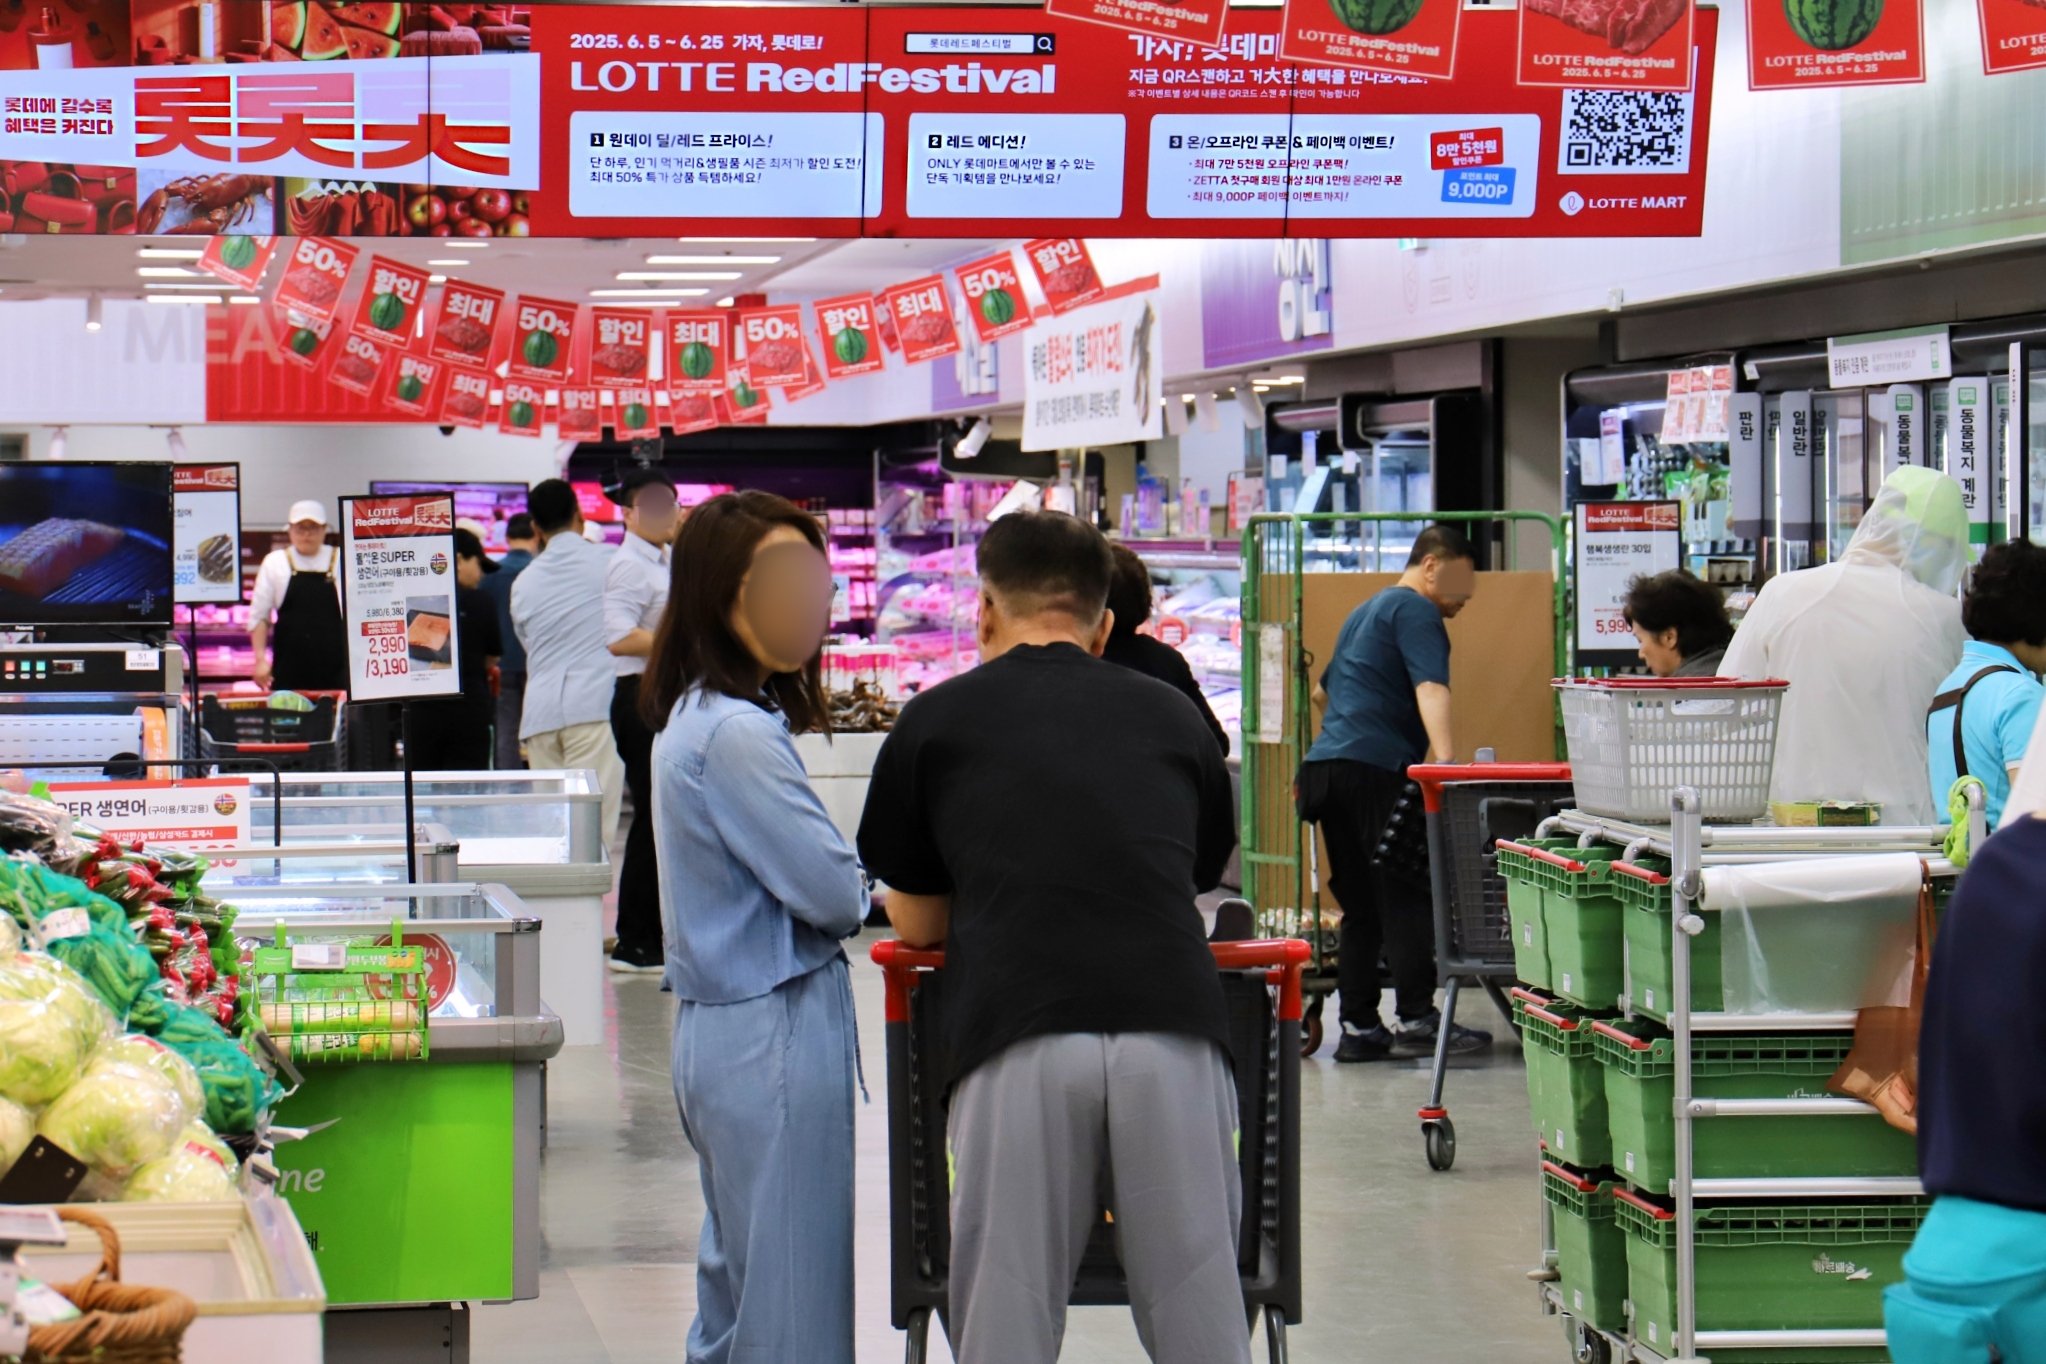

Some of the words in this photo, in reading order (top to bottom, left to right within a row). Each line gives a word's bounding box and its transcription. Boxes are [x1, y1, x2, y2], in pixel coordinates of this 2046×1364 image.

[1094, 4, 1123, 18] 2025.
[1163, 19, 1177, 28] 25
[570, 34, 624, 50] 2025.
[627, 34, 645, 49] 6.
[648, 34, 661, 49] 5
[680, 34, 697, 49] 6.
[700, 34, 724, 49] 25
[733, 35, 767, 52] 가자,
[771, 35, 823, 51] 롯데로!
[929, 38, 1012, 50] 롯데레드페스티벌
[1298, 29, 1346, 44] LOTTE
[1349, 35, 1440, 57] RedFestival
[2000, 32, 2046, 49] LOTTE
[1326, 44, 1354, 58] 2025.
[1396, 55, 1409, 64] 25
[1533, 54, 1582, 67] LOTTE
[1584, 56, 1675, 70] RedFestival
[1765, 54, 1813, 67] LOTTE
[1816, 50, 1907, 65] RedFestival
[571, 61, 736, 92] LOTTE
[747, 62, 1056, 94] RedFestival
[1129, 69, 1158, 83] 지금
[1163, 68, 1245, 85] QR스캔하고
[1302, 69, 1346, 85] 혜택을
[1562, 68, 1590, 79] 2025.
[1632, 69, 1646, 79] 25
[1795, 66, 1823, 77] 2025.
[1865, 64, 1878, 74] 25
[1183, 89, 1200, 98] 상세
[1203, 90, 1226, 98] 내용은
[1228, 90, 1257, 98] QR코드
[1260, 89, 1276, 98] 스캔
[1279, 90, 1288, 98] 후
[1319, 89, 1360, 99] 가능합니다
[5, 97, 56, 113] 롯데에
[61, 98, 113, 114] 갈수록
[5, 118, 56, 134] 혜택은
[62, 119, 114, 135] 커진다
[609, 133, 653, 149] 원데이
[657, 133, 706, 149] 딜/레드
[709, 133, 774, 149] 프라이스!
[946, 135, 974, 149] 레드
[978, 135, 1026, 149] 에디션!
[1187, 136, 1258, 150] 온/오프라인
[1261, 136, 1289, 149] 쿠폰
[1292, 137, 1303, 149] &
[1306, 136, 1345, 150] 페이백
[1349, 136, 1394, 150] 이벤트!
[1459, 132, 1474, 140] 최대
[1436, 143, 1459, 158] 8만
[1462, 140, 1498, 157] 5천원
[590, 157, 602, 169] 단
[605, 157, 632, 170] 하루,
[635, 157, 657, 169] 인기
[661, 156, 740, 170] 먹거리&생필품
[744, 157, 767, 169] 시즌
[770, 157, 805, 170] 최저가
[808, 157, 830, 169] 할인
[833, 157, 861, 170] 도전!
[928, 158, 960, 169] ONLY
[963, 158, 1043, 170] 롯데마트에서만
[1046, 158, 1057, 170] 볼
[1060, 158, 1070, 169] 수
[1073, 158, 1096, 170] 있는
[1194, 158, 1214, 169] 최대
[1217, 158, 1235, 169] 7만
[1238, 158, 1265, 170] 5천원
[1267, 158, 1309, 170] 오프라인
[1312, 158, 1348, 170] 쿠폰팩!
[1452, 156, 1483, 166] 할인쿠폰
[590, 171, 613, 184] 최대
[616, 171, 643, 183] 50%
[646, 171, 668, 183] 특가
[672, 171, 694, 184] 상품
[697, 171, 761, 185] 득템하세요!
[926, 173, 949, 184] 단독
[953, 173, 997, 185] 기획템을
[1000, 172, 1061, 185] 만나보세요!
[1193, 175, 1228, 185] ZETTA
[1231, 175, 1259, 185] 첫구매
[1261, 175, 1280, 185] 회원
[1283, 175, 1303, 185] 대상
[1305, 175, 1324, 185] 최대
[1327, 175, 1350, 185] 1만원
[1353, 175, 1381, 185] 온라인
[1384, 175, 1403, 185] 쿠폰
[1460, 172, 1482, 181] 포인트
[1484, 173, 1499, 182] 최대
[1193, 191, 1213, 202] 최대
[1215, 191, 1255, 203] 9,000P
[1258, 191, 1288, 202] 페이백
[1292, 190, 1347, 202] 이벤트까지!
[1448, 182, 1509, 199] 9,000P
[1589, 198, 1638, 209] LOTTE
[1641, 196, 1688, 209] MART
[295, 238, 346, 280] 50%
[1034, 238, 1084, 275] 할인
[372, 267, 421, 305] 할인
[964, 267, 1017, 300] 50%
[447, 291, 496, 326] 최대
[896, 286, 943, 319] 최대
[518, 305, 571, 337] 50%
[822, 302, 871, 337] 할인
[598, 319, 645, 347] 할인
[674, 321, 721, 348] 최대
[746, 317, 799, 342] 50%
[345, 337, 383, 366] 50%
[401, 356, 434, 384] 할인
[455, 373, 488, 399] 최대
[505, 383, 544, 405] 50%
[562, 389, 597, 411] 할인
[1738, 410, 1754, 442] 판란
[1792, 410, 1808, 458] 일반란
[1960, 408, 1976, 472] 동물복지
[1961, 477, 1977, 510] 계란
[368, 507, 400, 518] LOTTE
[1587, 516, 1643, 524] RedFestival
[1600, 508, 1630, 517] LOTTE
[355, 515, 414, 528] RedFestival
[381, 549, 416, 563] SUPER
[1586, 543, 1630, 555] 행복생생란
[1632, 543, 1652, 554] 30입
[356, 566, 380, 581] 생연어
[368, 634, 407, 657] 2,990
[366, 656, 409, 679] /3,190
[95, 798, 147, 819] 생연어
[148, 803, 210, 816] (구이용/횟감용)
